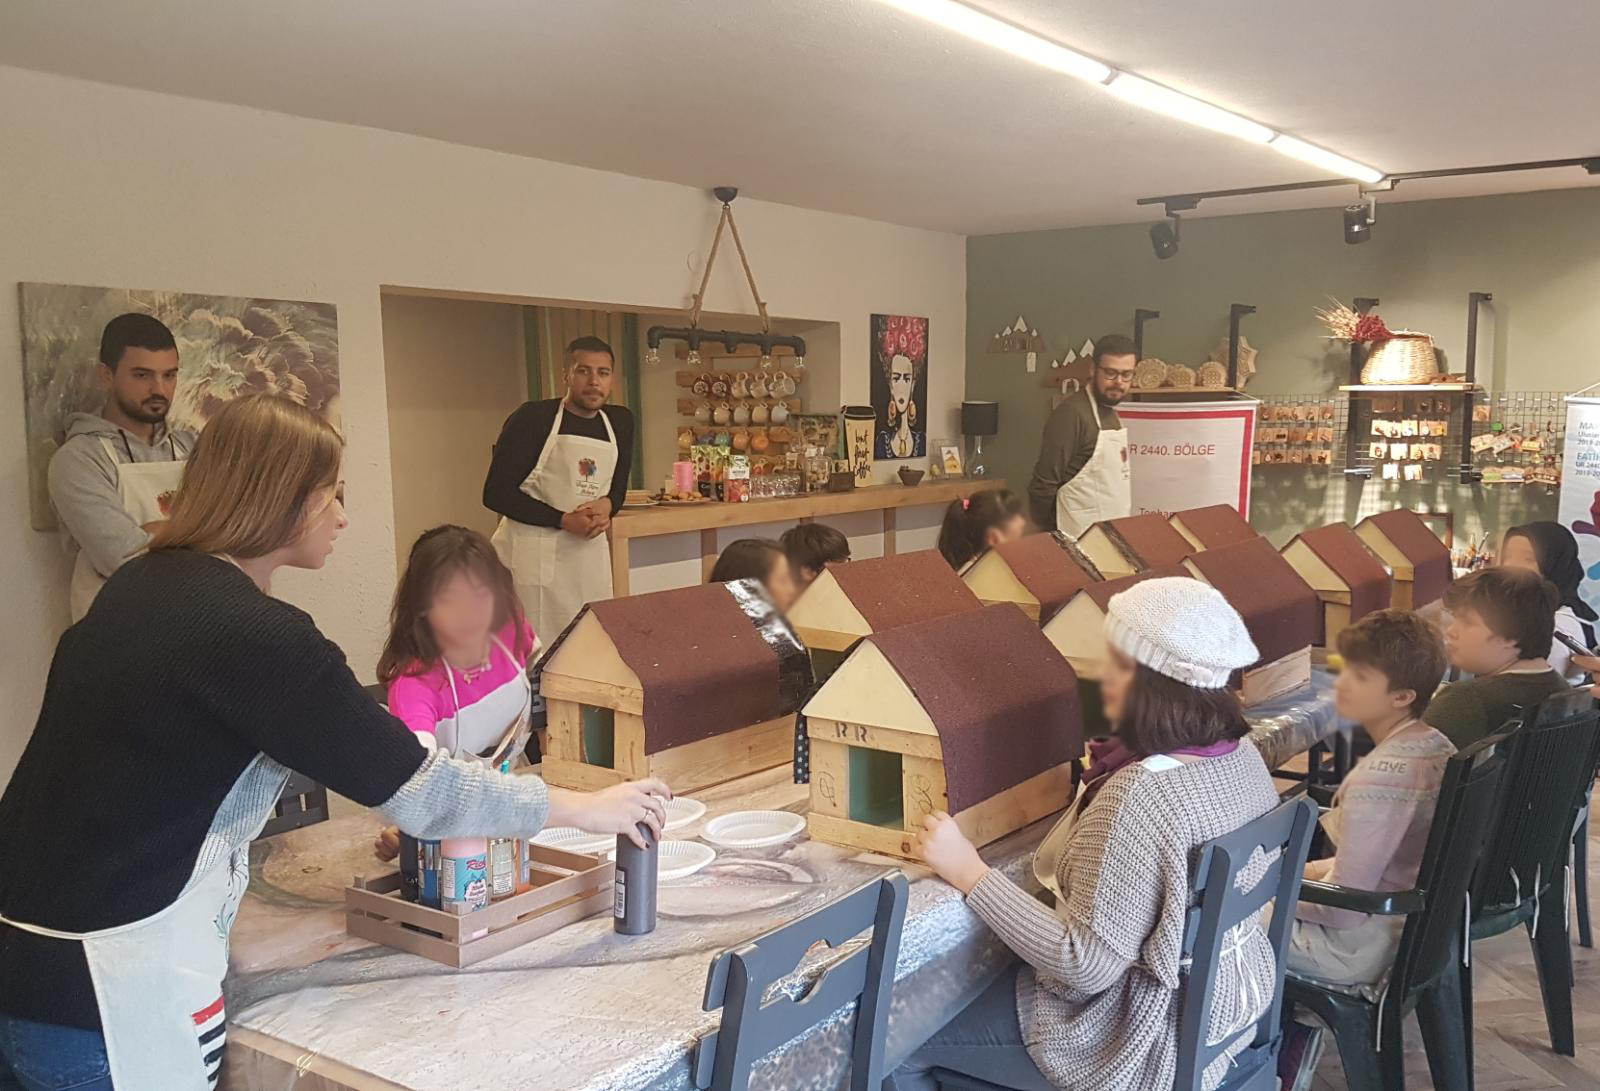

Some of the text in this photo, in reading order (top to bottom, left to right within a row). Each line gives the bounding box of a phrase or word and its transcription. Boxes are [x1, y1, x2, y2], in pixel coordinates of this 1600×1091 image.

[1128, 442, 1216, 456] R 2440. BÖLGE
[1369, 760, 1407, 774] LOVE
